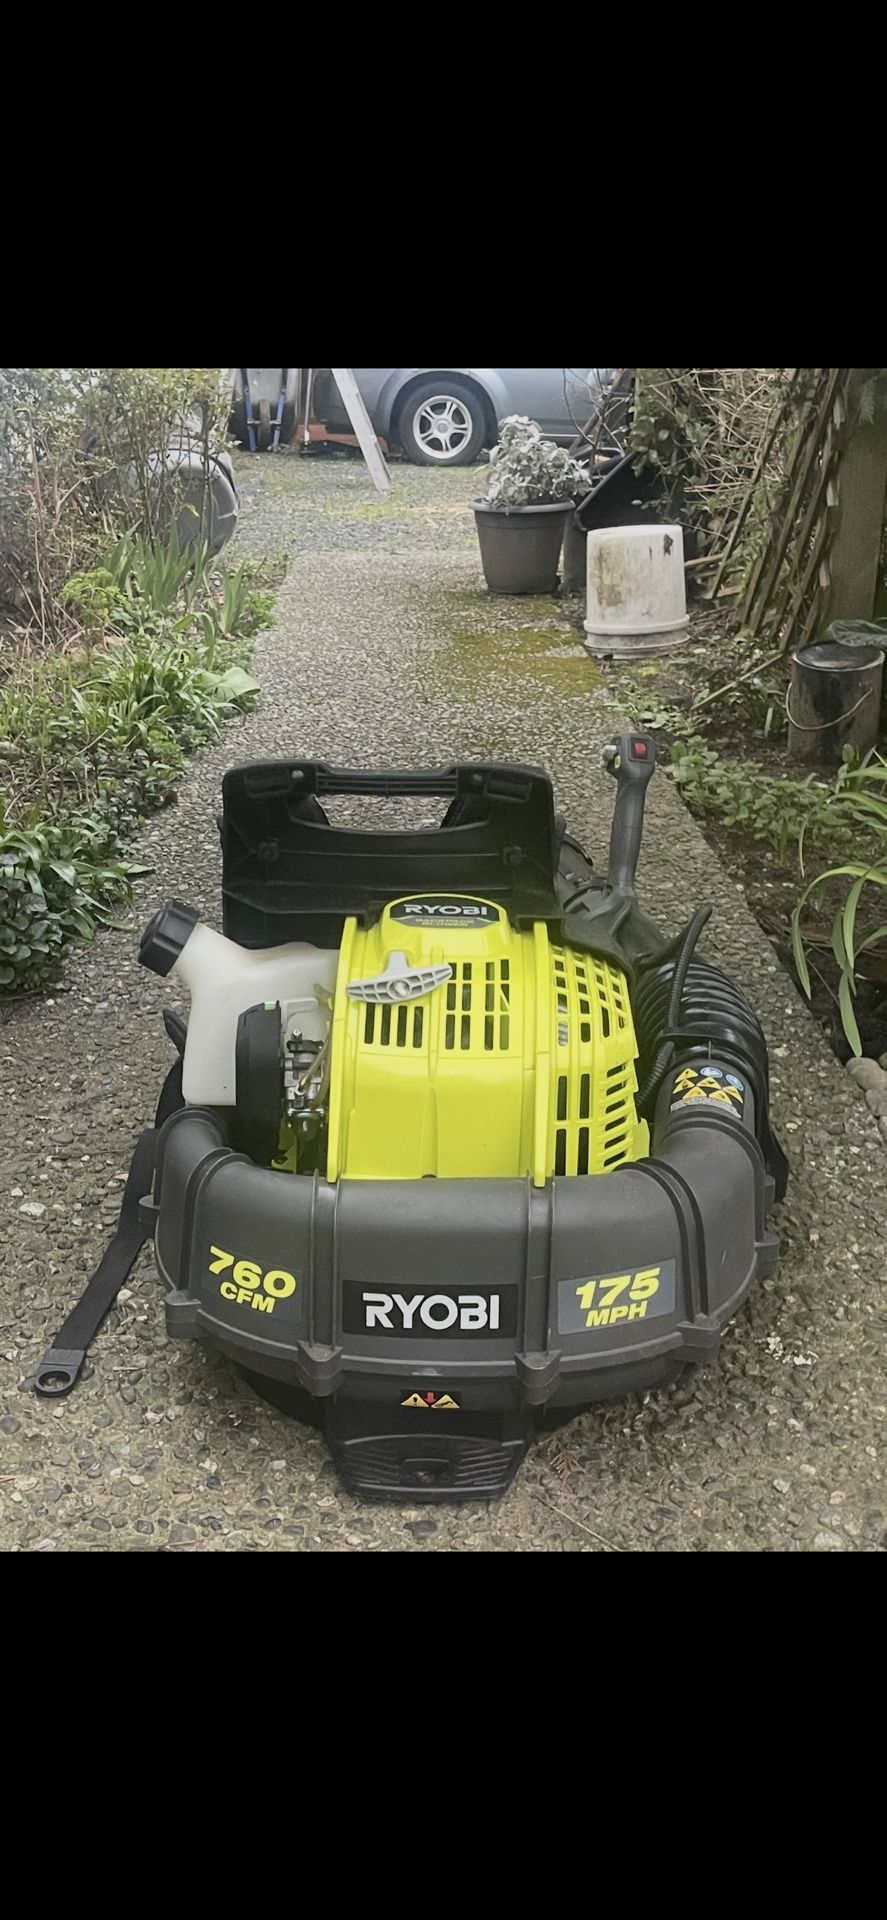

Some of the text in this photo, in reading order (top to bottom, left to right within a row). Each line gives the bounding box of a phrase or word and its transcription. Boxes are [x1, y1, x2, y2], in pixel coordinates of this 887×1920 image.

[404, 904, 488, 916] RYOBI
[209, 1245, 296, 1298] 760
[575, 1267, 661, 1310] 175
[220, 1281, 276, 1313] CFM
[362, 1292, 500, 1330] RYOBI
[585, 1300, 648, 1328] MPH
